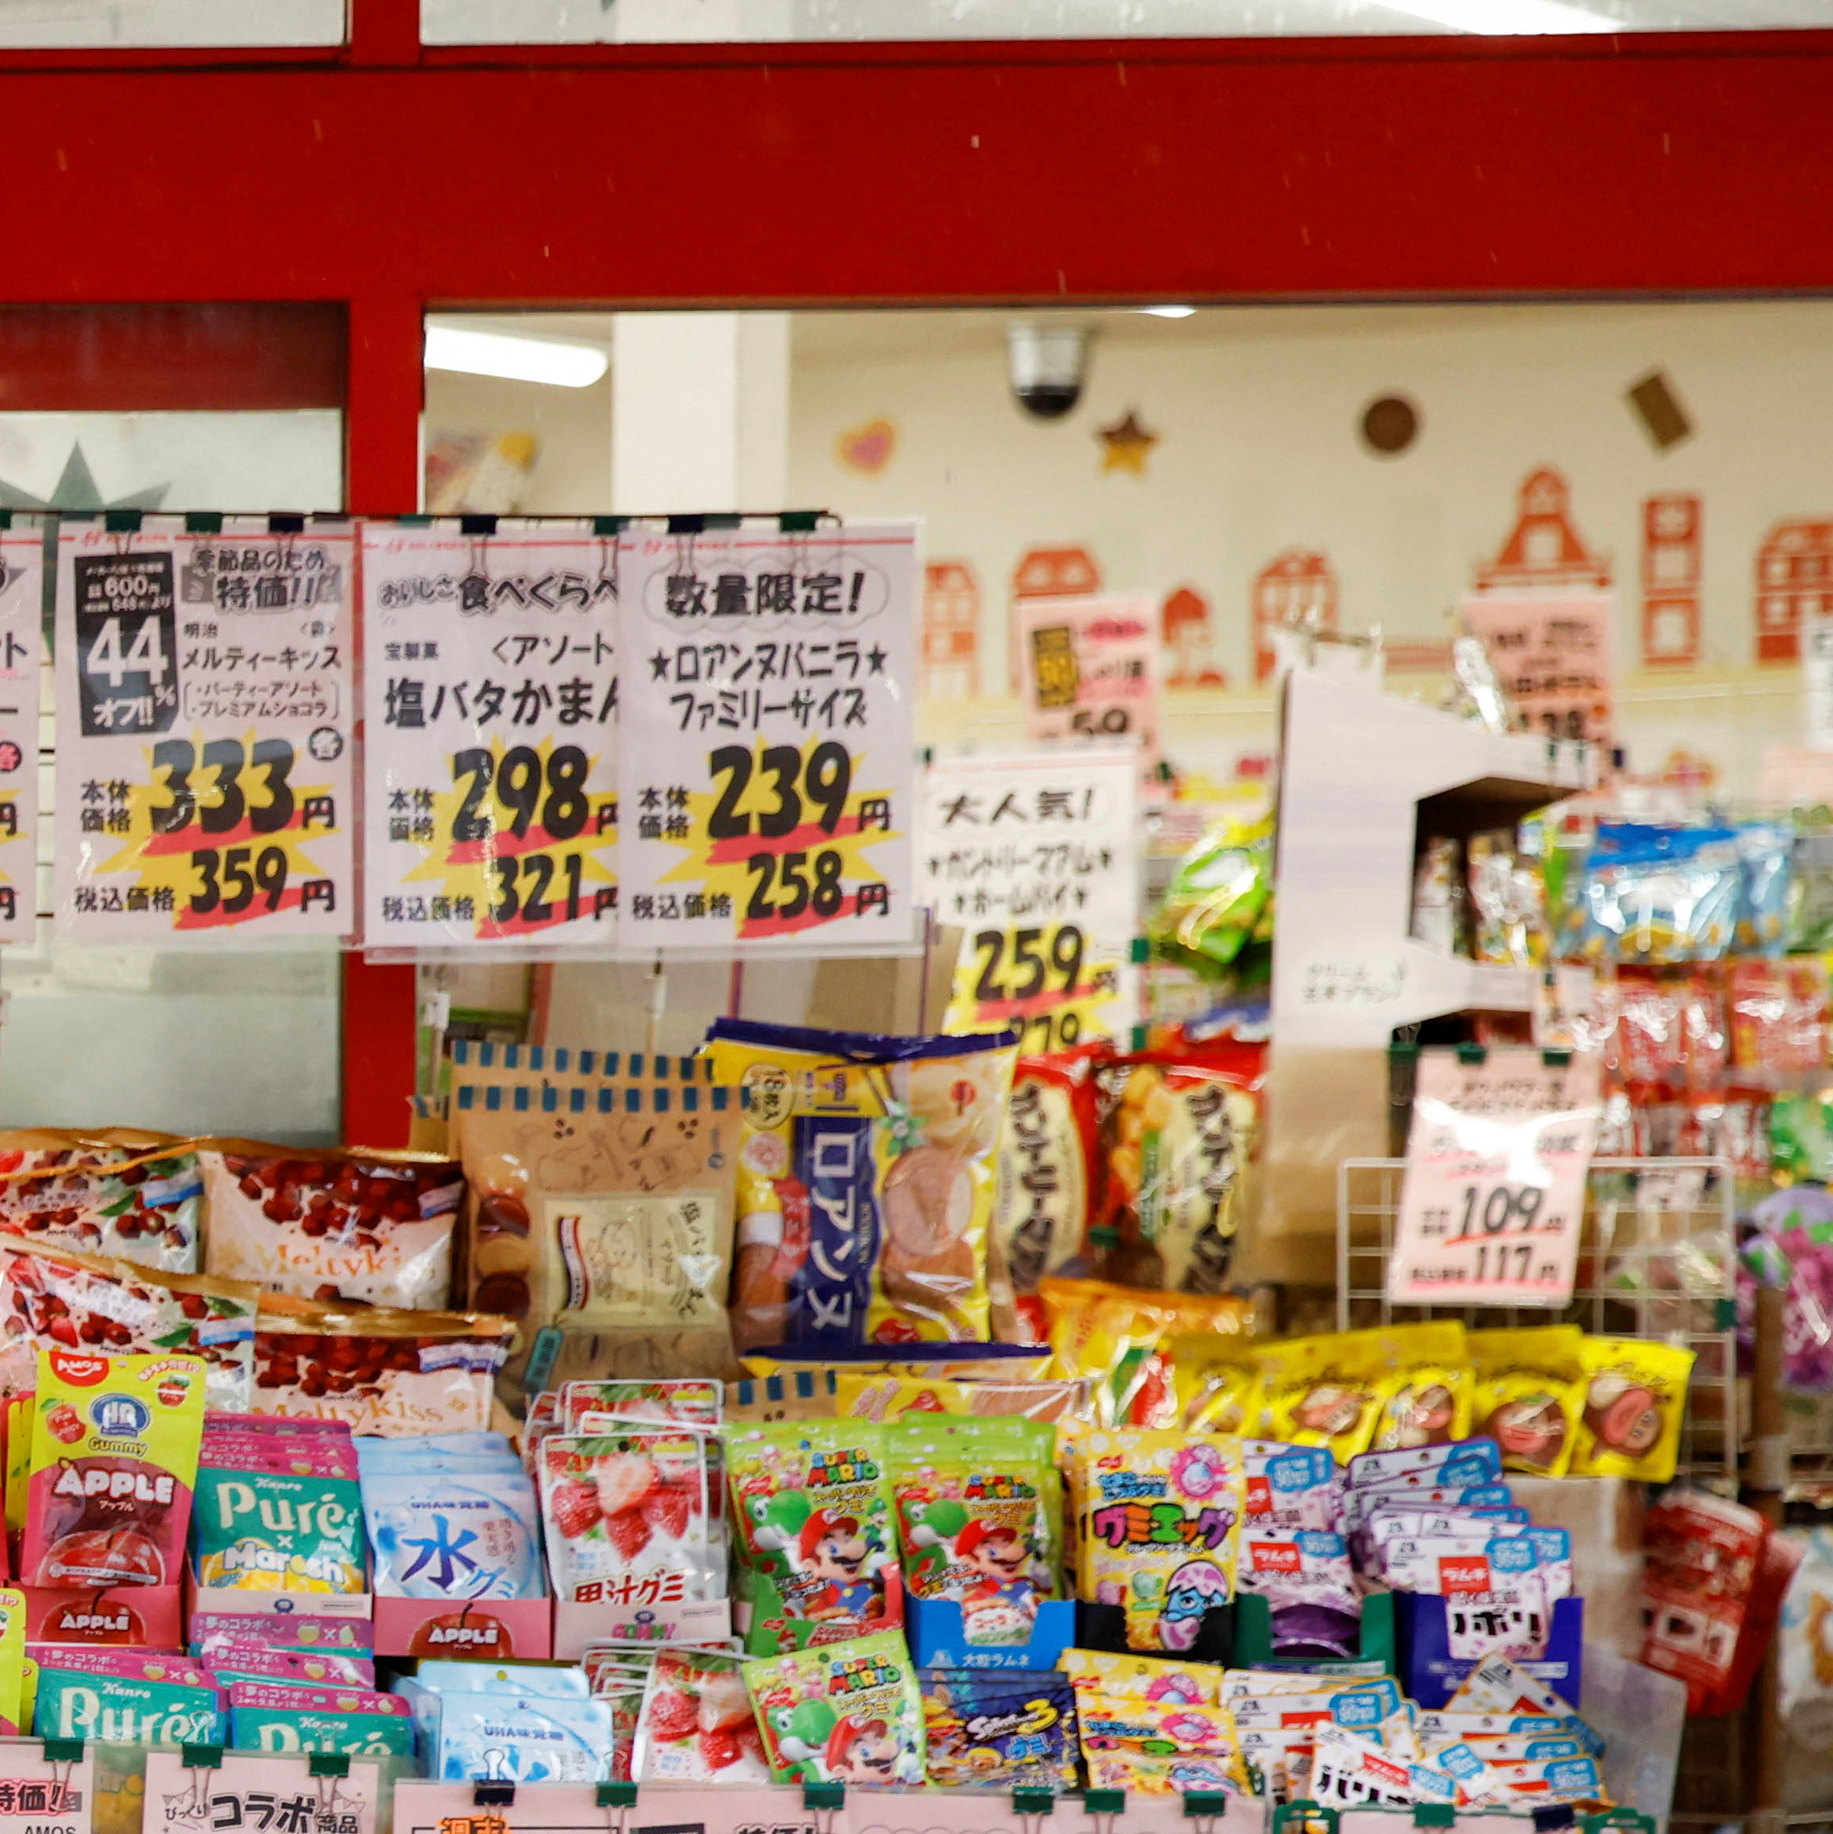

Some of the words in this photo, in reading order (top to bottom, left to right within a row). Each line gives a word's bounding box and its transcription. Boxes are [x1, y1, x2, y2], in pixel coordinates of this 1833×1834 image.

[667, 572, 863, 616] 数量限定!
[84, 614, 169, 688] 44
[182, 644, 342, 672] メルティーキッス
[669, 688, 867, 730] ファミリーサイズ
[53, 1459, 175, 1505] APPLE
[216, 1482, 345, 1532] Puré
[1094, 1501, 1237, 1549] グミエッグ
[399, 1515, 478, 1585] 水
[212, 1795, 315, 1831] コラボ
